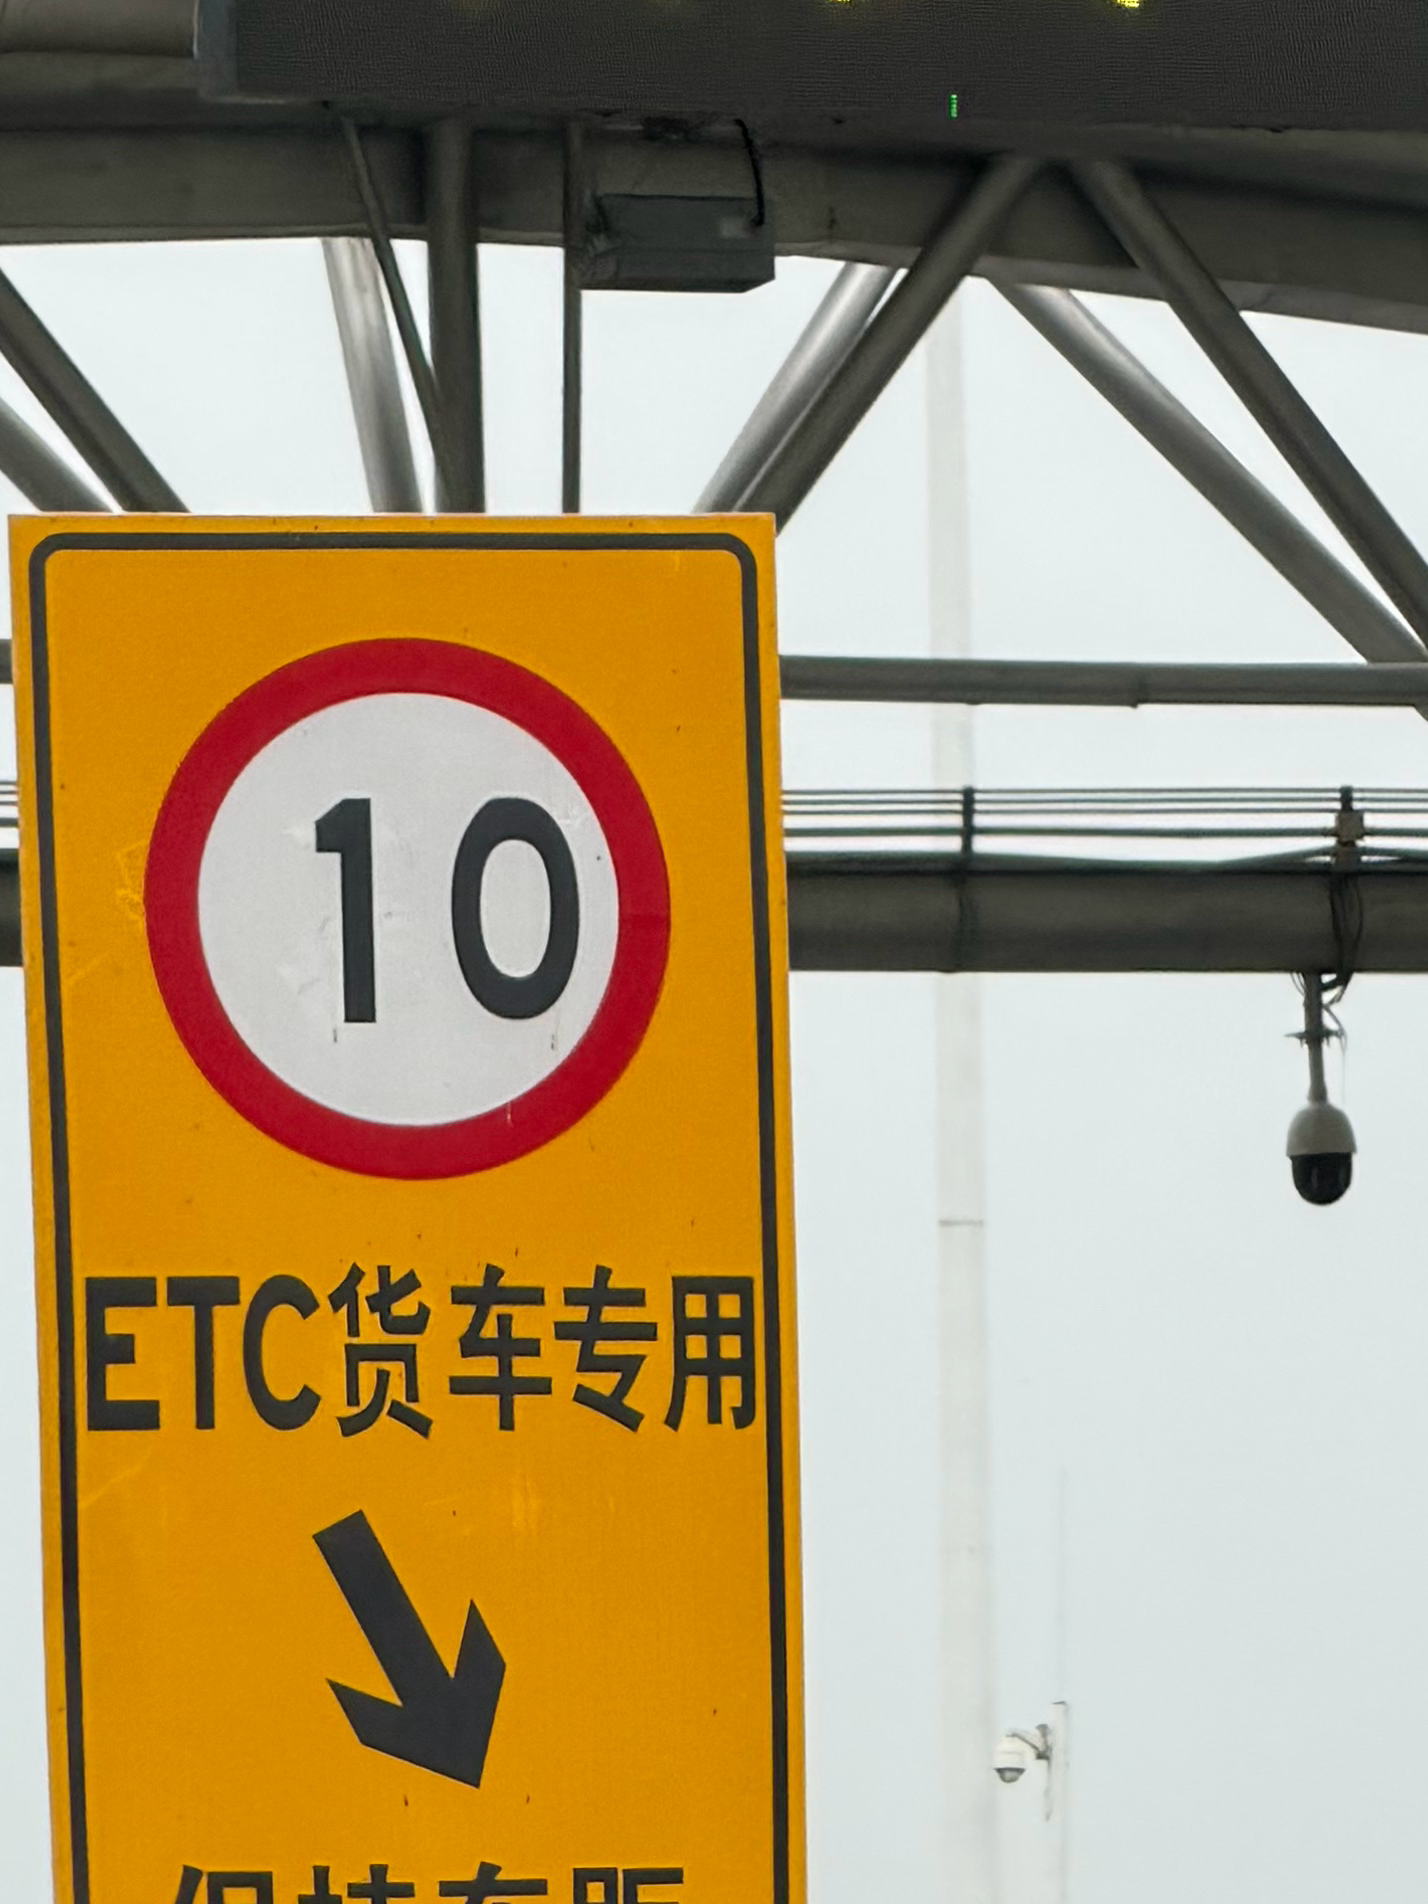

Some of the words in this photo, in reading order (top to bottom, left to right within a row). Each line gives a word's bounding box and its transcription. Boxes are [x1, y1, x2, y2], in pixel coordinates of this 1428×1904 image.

[314, 796, 580, 1024] 10
[85, 1263, 756, 1440] ETC货车专用
